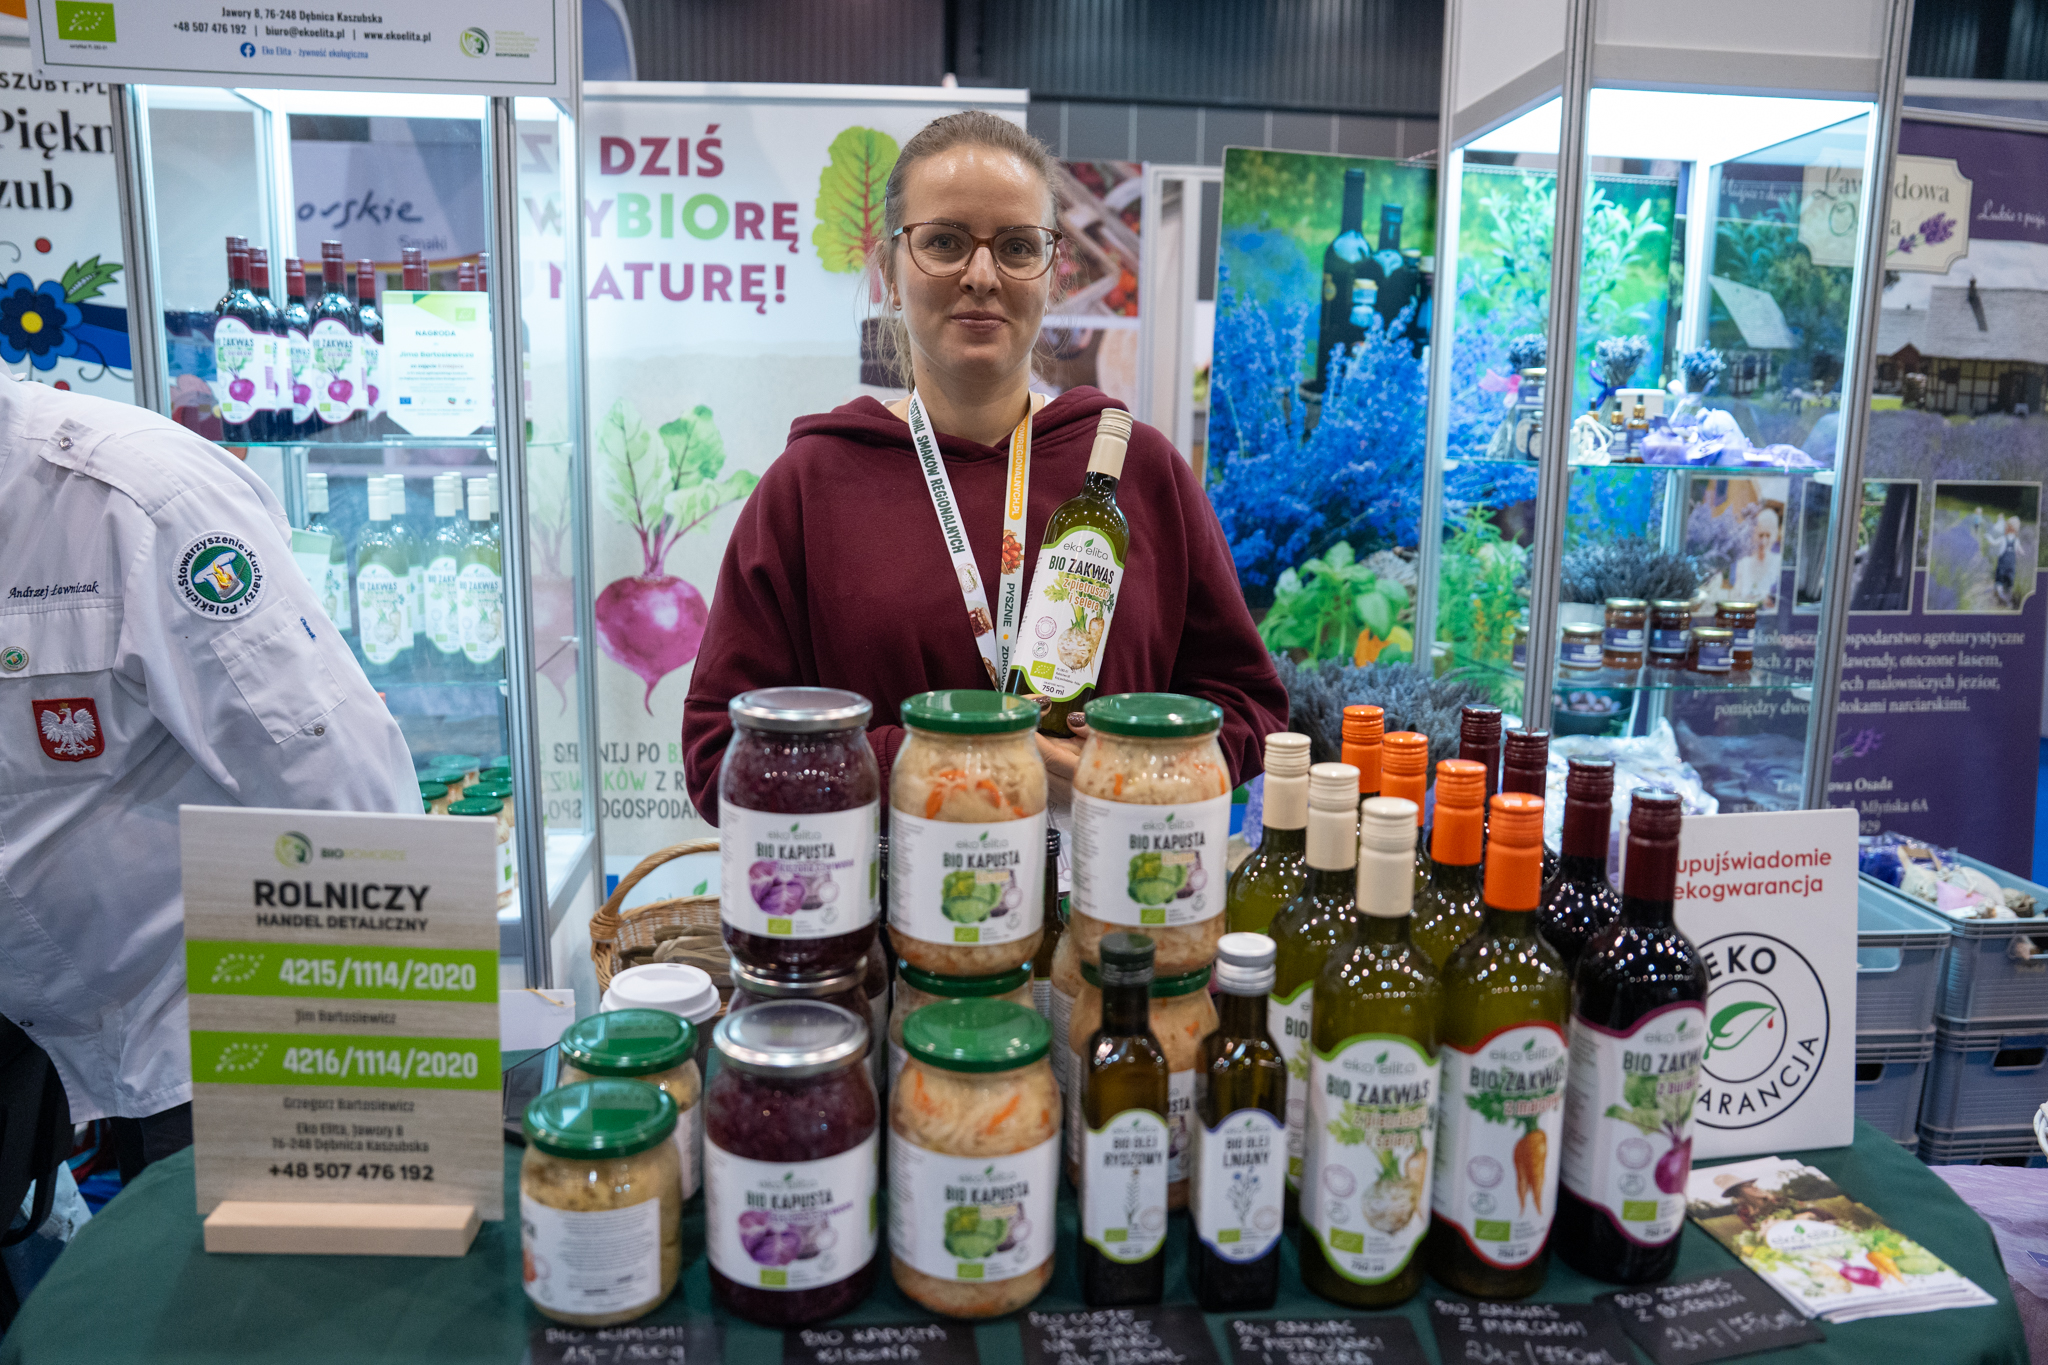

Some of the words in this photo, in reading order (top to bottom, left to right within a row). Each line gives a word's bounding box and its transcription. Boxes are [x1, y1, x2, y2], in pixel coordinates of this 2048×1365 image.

[222, 7, 252, 20] Jawory
[254, 8, 263, 20] 8,
[265, 8, 297, 20] 76-248
[299, 10, 335, 24] Dębnica
[337, 11, 383, 24] Kaszubska
[173, 21, 190, 32] +48
[192, 21, 209, 33] 507
[212, 22, 228, 34] 476
[231, 23, 247, 35] 192
[265, 25, 345, 40] biuro@ekoelita.pl
[364, 30, 431, 43] www.ekoelita.pl
[600, 123, 725, 178] DZIŚ
[415, 329, 457, 337] NAGRODA
[916, 434, 940, 477] SMAKÓW
[178, 535, 246, 588] Stowarzyszenie
[1063, 541, 1083, 553] eko
[1085, 546, 1109, 561] elita
[243, 550, 264, 606] Kucharzy
[1048, 555, 1067, 571] BIO
[1067, 558, 1115, 585] ZAKWAS
[8, 585, 50, 601] Andrzej
[367, 580, 398, 591] ZAKWAS
[468, 580, 499, 591] ZAKWAS
[1069, 579, 1110, 600] pietruszki
[184, 587, 239, 616] Polskich
[1002, 582, 1016, 628] PYSZNIE
[1923, 630, 2026, 649] agroturystyczne
[1900, 653, 1956, 668] otoczone
[1957, 650, 2003, 670] lasem,
[1042, 684, 1055, 693] 750
[1055, 688, 1065, 696] ml
[1867, 674, 1955, 693] malowniczych
[1714, 697, 1777, 720] pomiędzy
[1889, 696, 1971, 714] narciarskimi.
[637, 742, 661, 763] PO
[655, 770, 667, 791] Z
[767, 830, 790, 840] eko
[1142, 820, 1166, 831] eko
[756, 841, 776, 858] BIO
[778, 841, 836, 860] KAPUSTA
[956, 839, 980, 849] eko
[1129, 833, 1149, 850] BIO
[1153, 831, 1205, 850] KAPUSTA
[943, 851, 963, 868] BIO
[967, 850, 1021, 869] KAPUSTA
[253, 879, 431, 911] ROLNICZY
[256, 913, 325, 929] HANDEL
[327, 915, 429, 932] DETALICZNY
[1703, 945, 1777, 982] EKO
[279, 957, 477, 992] 4215/1114/2020
[318, 1008, 397, 1025] Bartosiewicz
[1285, 1016, 1308, 1039] BIO
[282, 1045, 479, 1080] 4216/1114/2020
[1622, 1050, 1652, 1073] BIO
[1469, 1066, 1499, 1088] BIO
[1697, 1034, 1820, 1116] ARANCJA
[1326, 1072, 1351, 1099] BIO
[1356, 1078, 1432, 1106] ZAKWAS
[283, 1098, 335, 1113] Grzegorz
[338, 1098, 415, 1113] Bartosiewicz
[295, 1123, 317, 1136] Eko
[352, 1124, 394, 1138] Jawory
[272, 1137, 312, 1150] 76-248
[314, 1137, 364, 1153] Dębnica
[366, 1138, 429, 1153] Kaszubska
[269, 1162, 309, 1179] +48
[313, 1162, 351, 1180] 507
[356, 1163, 395, 1180] 476
[400, 1164, 435, 1182] 192
[771, 1187, 834, 1209] KAPUSTA
[971, 1180, 1029, 1203] KAPUSTA
